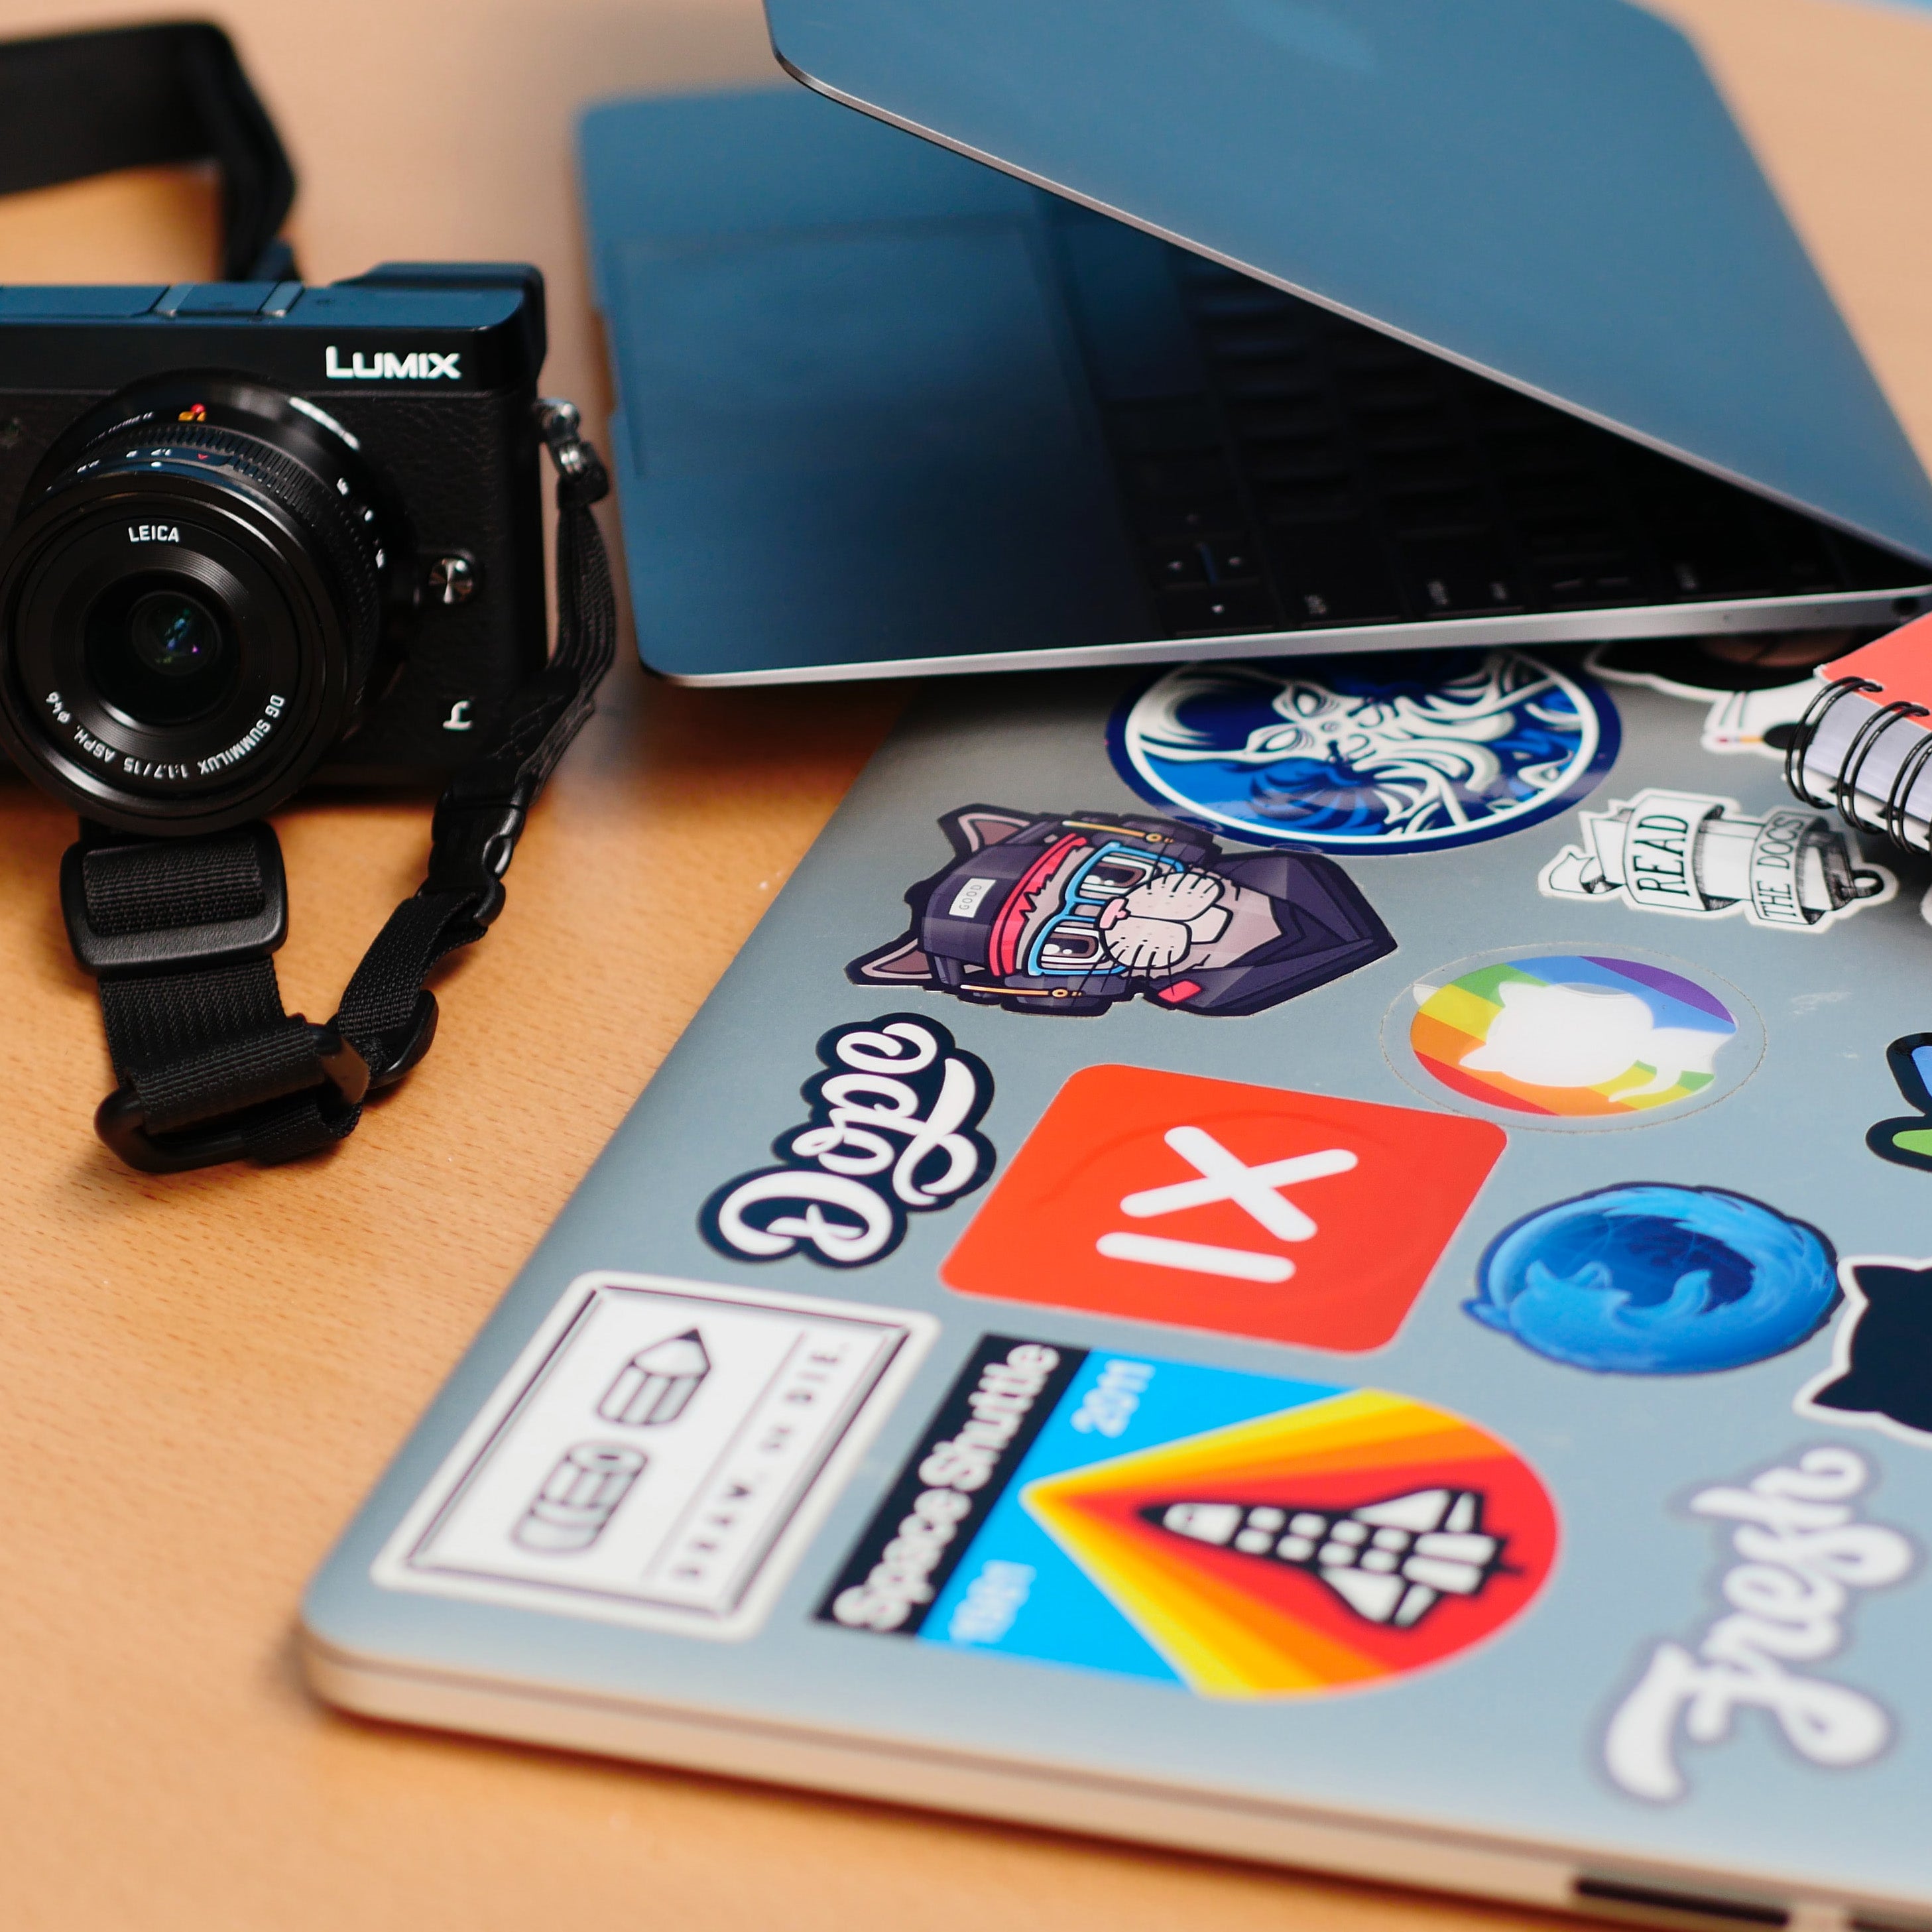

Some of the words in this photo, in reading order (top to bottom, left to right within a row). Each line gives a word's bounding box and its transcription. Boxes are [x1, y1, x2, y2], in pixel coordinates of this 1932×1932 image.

[326, 345, 461, 379] LUMIX
[128, 525, 179, 542] LEICA
[265, 694, 285, 719] DG
[197, 719, 271, 775] SUMMILUX
[1633, 815, 1689, 897] READ
[1757, 817, 1804, 869] DOCS
[959, 884, 982, 910] GOOD
[1756, 880, 1797, 918] THE
[718, 1022, 979, 1261] Dope
[833, 1488, 972, 1631] Space
[919, 1344, 1059, 1490] Shuttle
[1605, 1446, 1912, 1801] Fresh
